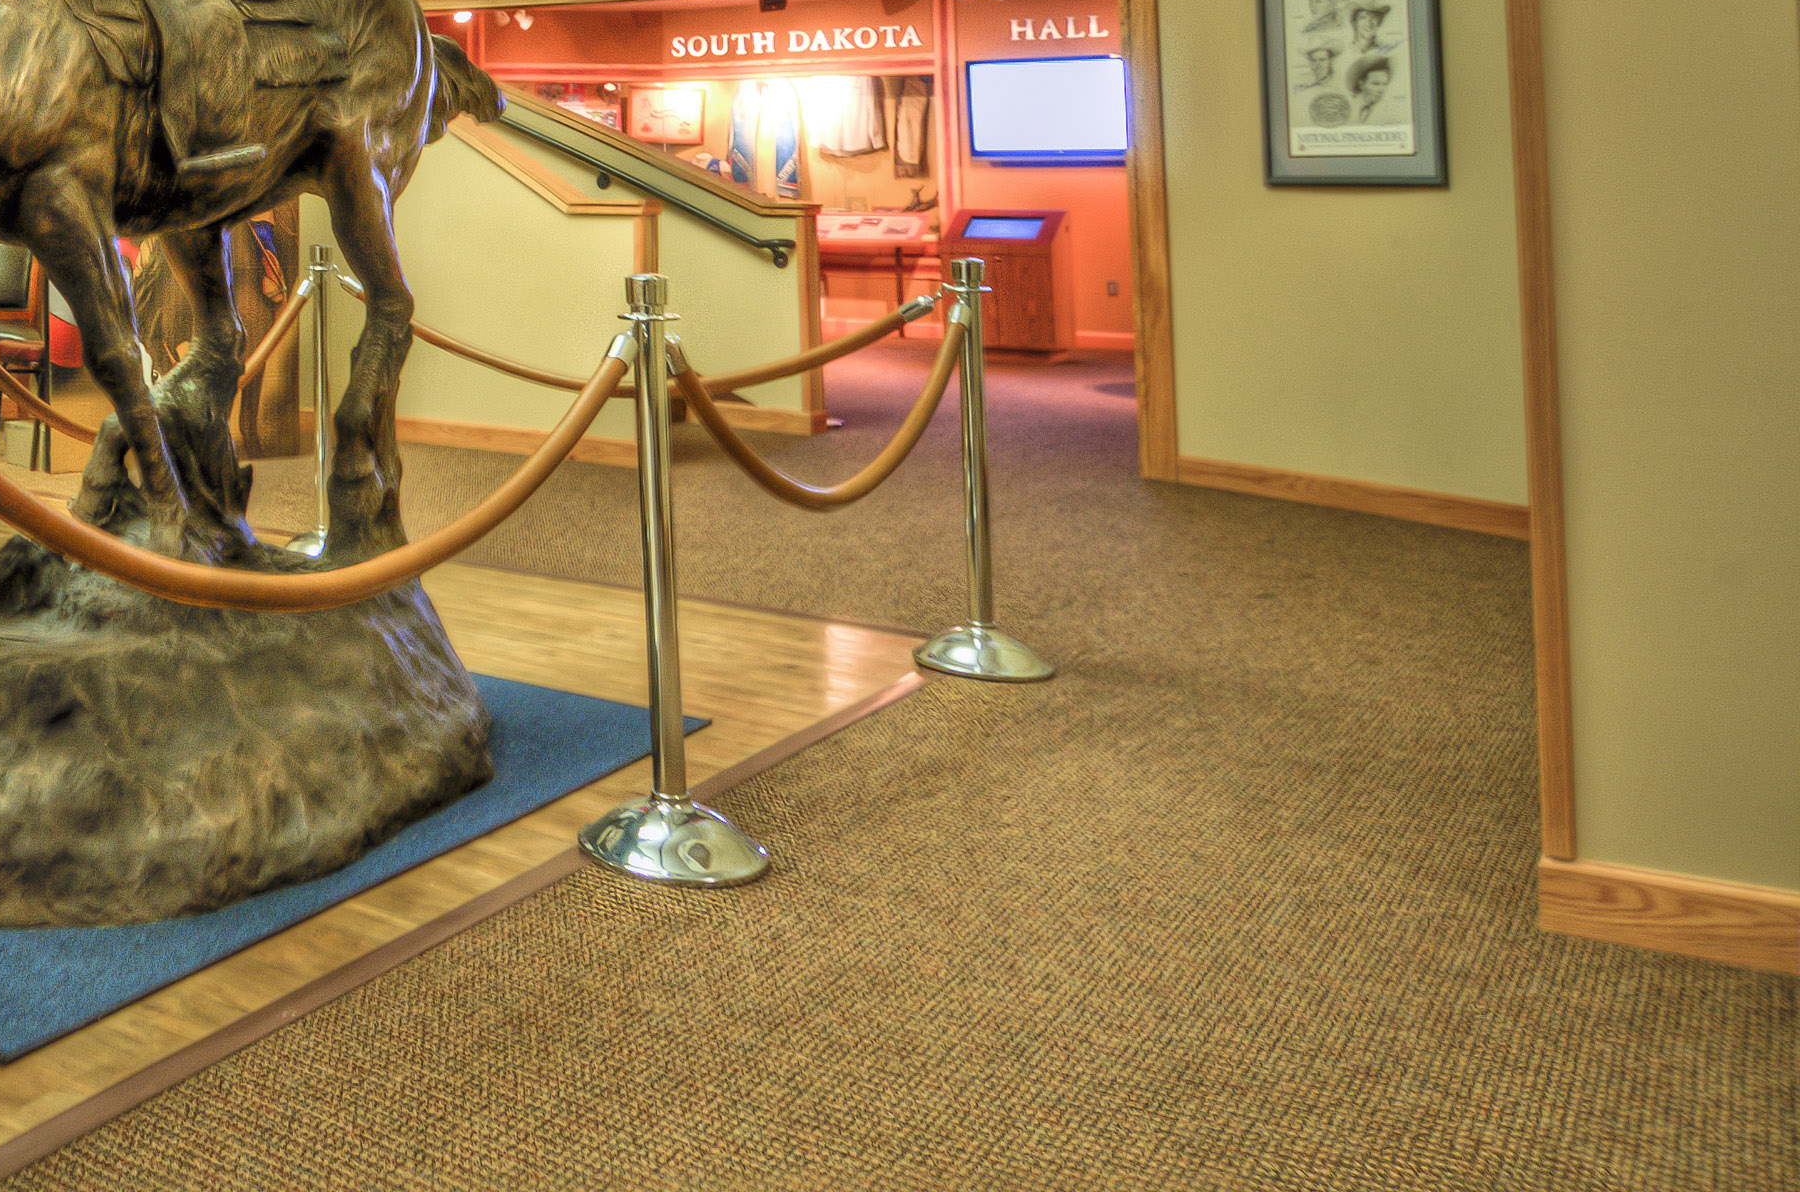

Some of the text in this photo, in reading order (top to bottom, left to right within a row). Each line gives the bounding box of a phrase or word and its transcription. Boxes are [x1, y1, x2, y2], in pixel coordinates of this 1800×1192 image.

[671, 15, 1110, 58] SOUTH DAKOTA HALL
